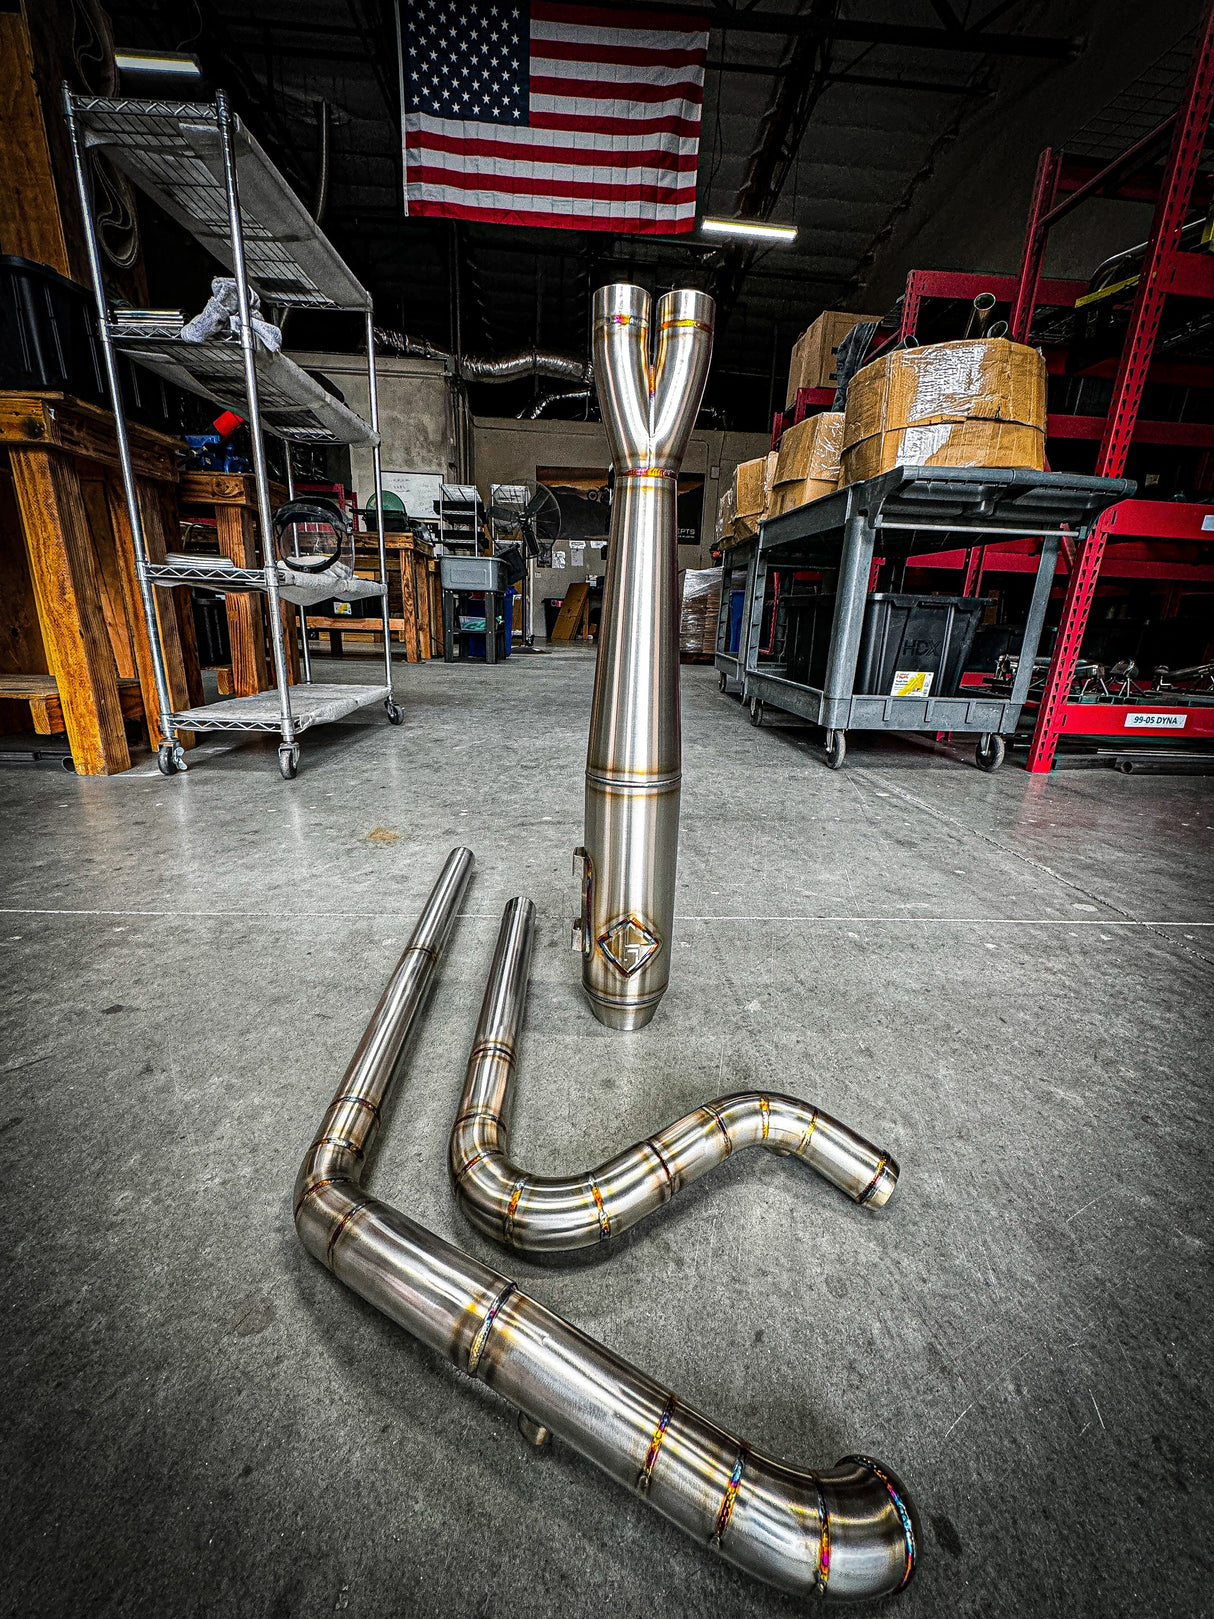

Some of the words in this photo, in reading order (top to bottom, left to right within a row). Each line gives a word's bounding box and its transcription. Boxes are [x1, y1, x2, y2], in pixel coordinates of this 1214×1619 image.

[902, 639, 941, 656] HDX
[1133, 716, 1155, 724] 99-05
[1156, 716, 1178, 725] DYNA
